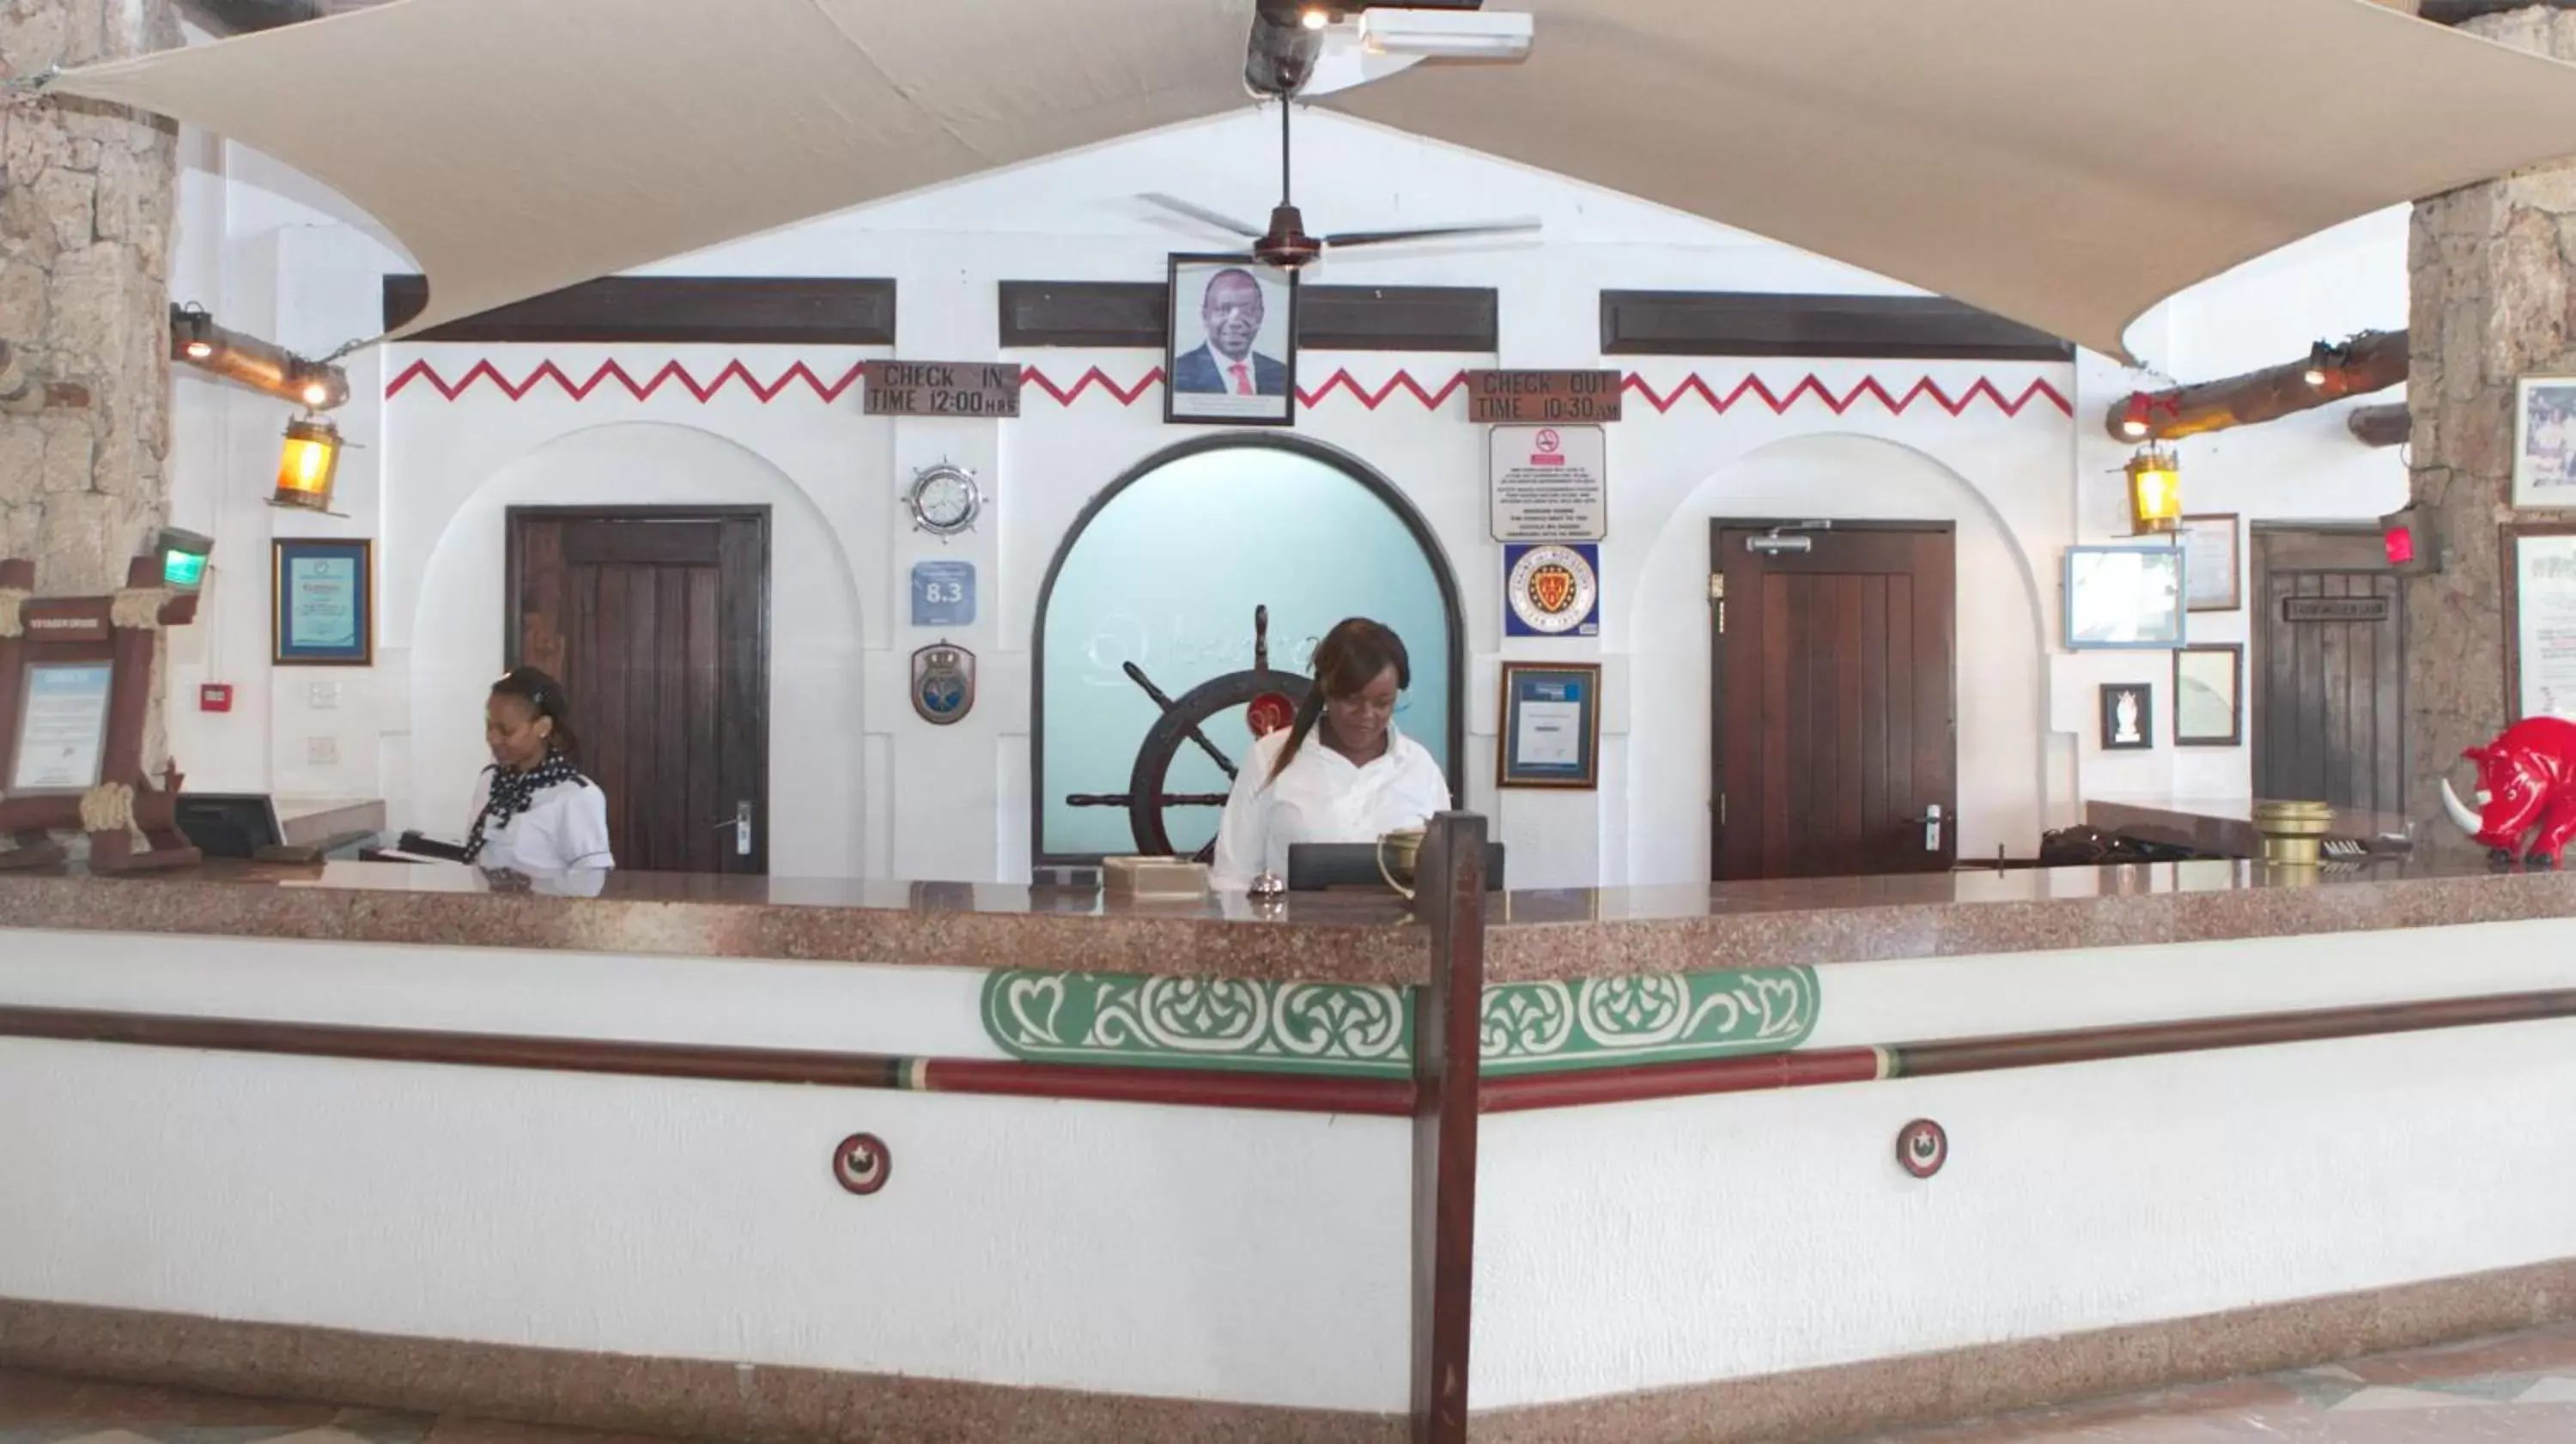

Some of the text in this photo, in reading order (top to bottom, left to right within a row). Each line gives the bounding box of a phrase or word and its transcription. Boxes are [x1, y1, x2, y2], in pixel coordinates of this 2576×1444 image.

[884, 365, 1003, 388] CHECK IN
[1483, 372, 1609, 394] CHECK OUT
[870, 389, 916, 411] TIME
[1477, 397, 1522, 418] TIME
[927, 582, 963, 603] 8.3
